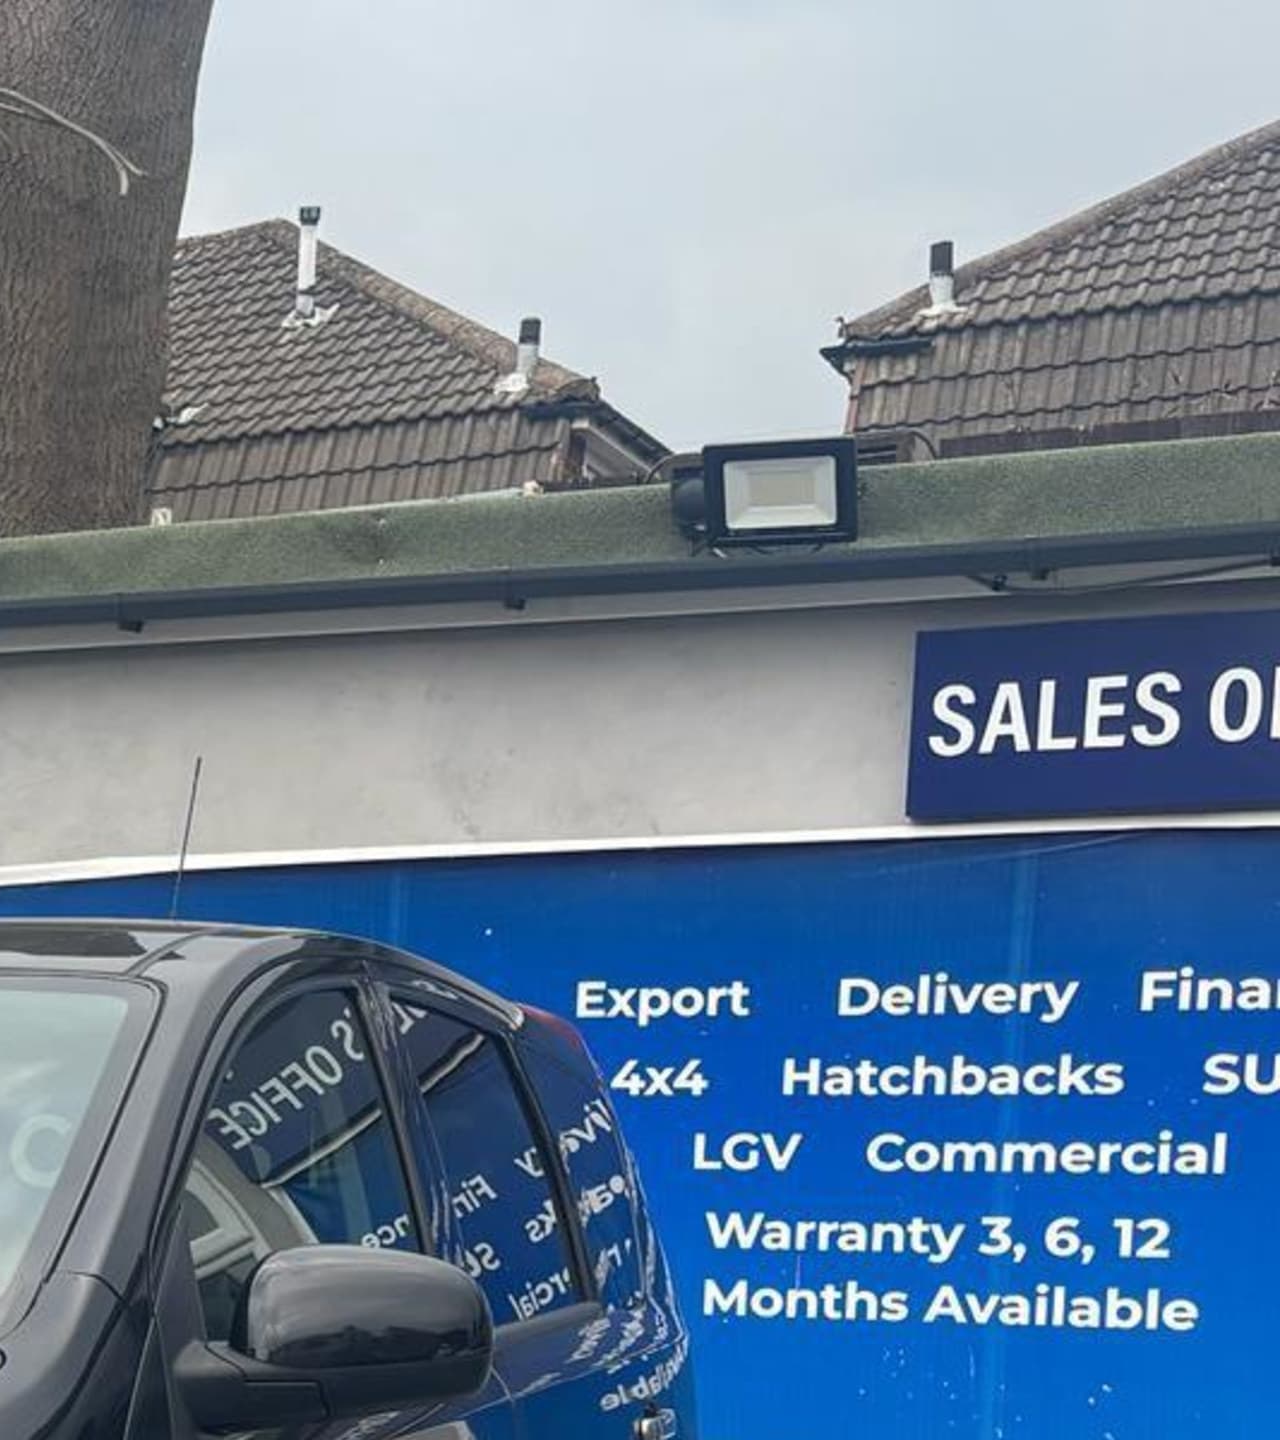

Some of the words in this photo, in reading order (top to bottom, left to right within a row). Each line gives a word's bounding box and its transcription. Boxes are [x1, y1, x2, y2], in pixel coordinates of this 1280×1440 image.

[928, 671, 1182, 757] SALES
[576, 981, 749, 1026] Export
[838, 972, 1079, 1023] Delivery
[1140, 966, 1280, 1011] Fina
[610, 1059, 708, 1096] 4x4
[782, 1054, 1124, 1096] Hatchbacks
[694, 1133, 802, 1171] LGV
[866, 1130, 1227, 1174] Commercial
[706, 1212, 965, 1263] Warranty
[979, 1216, 1026, 1263] 3,
[1044, 1217, 1094, 1264] 6,
[1113, 1218, 1170, 1258] 12
[703, 1279, 909, 1321] Months
[923, 1283, 1199, 1331] Available
